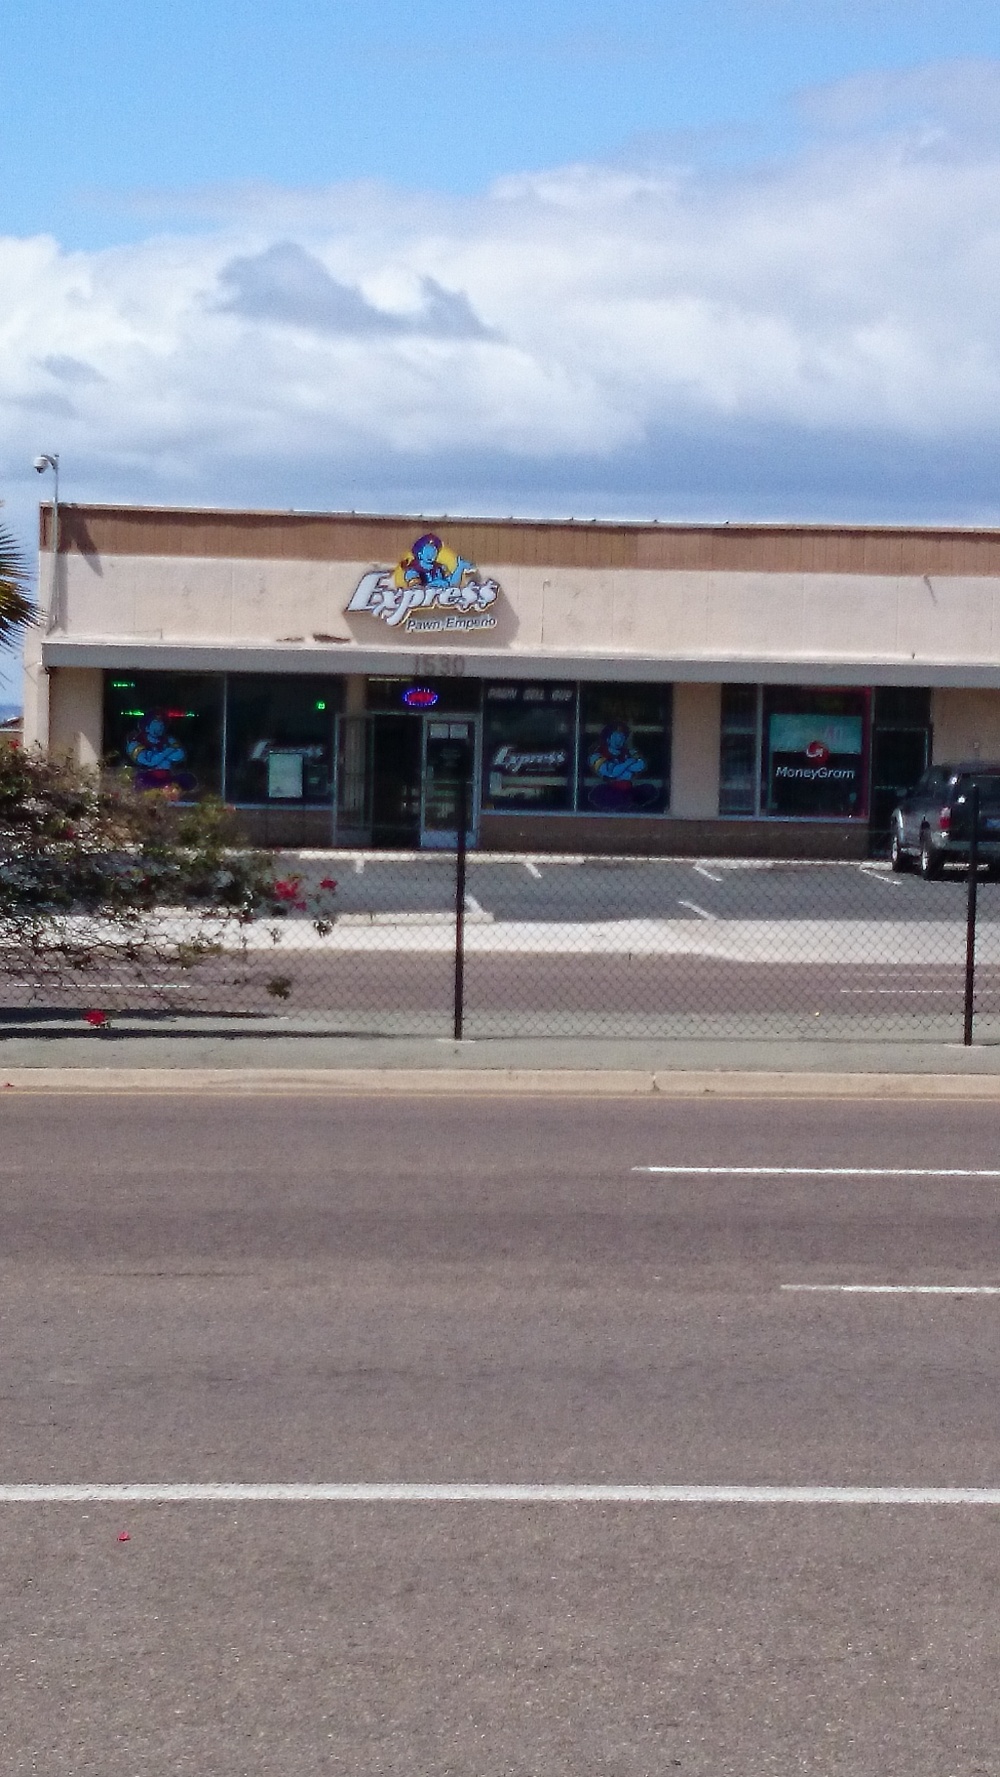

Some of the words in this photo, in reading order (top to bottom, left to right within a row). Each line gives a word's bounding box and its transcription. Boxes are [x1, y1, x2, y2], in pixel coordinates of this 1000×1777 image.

[348, 570, 500, 626] Express
[407, 618, 441, 631] Pawn
[775, 766, 855, 780] MoneyGram
